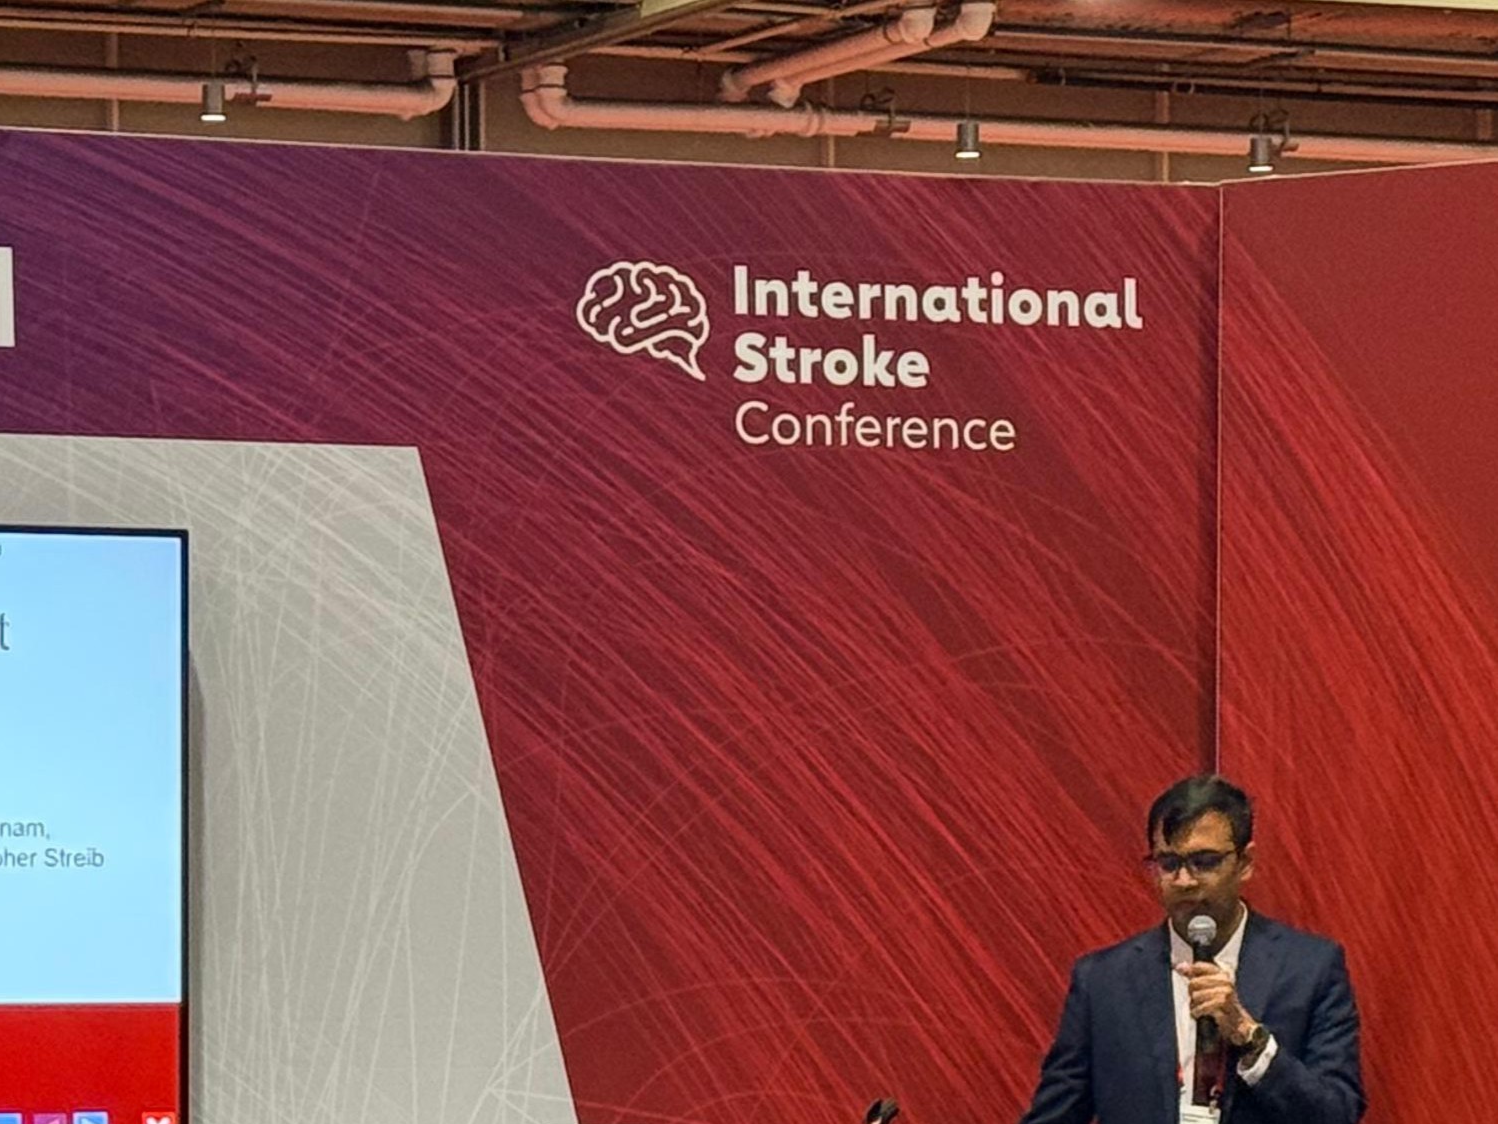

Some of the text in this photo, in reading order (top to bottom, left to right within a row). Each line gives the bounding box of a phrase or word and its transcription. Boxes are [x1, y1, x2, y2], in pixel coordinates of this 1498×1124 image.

[733, 265, 1143, 329] International
[733, 333, 930, 388] Stroke
[735, 400, 1016, 451] Conference
[44, 847, 105, 869] Streib
